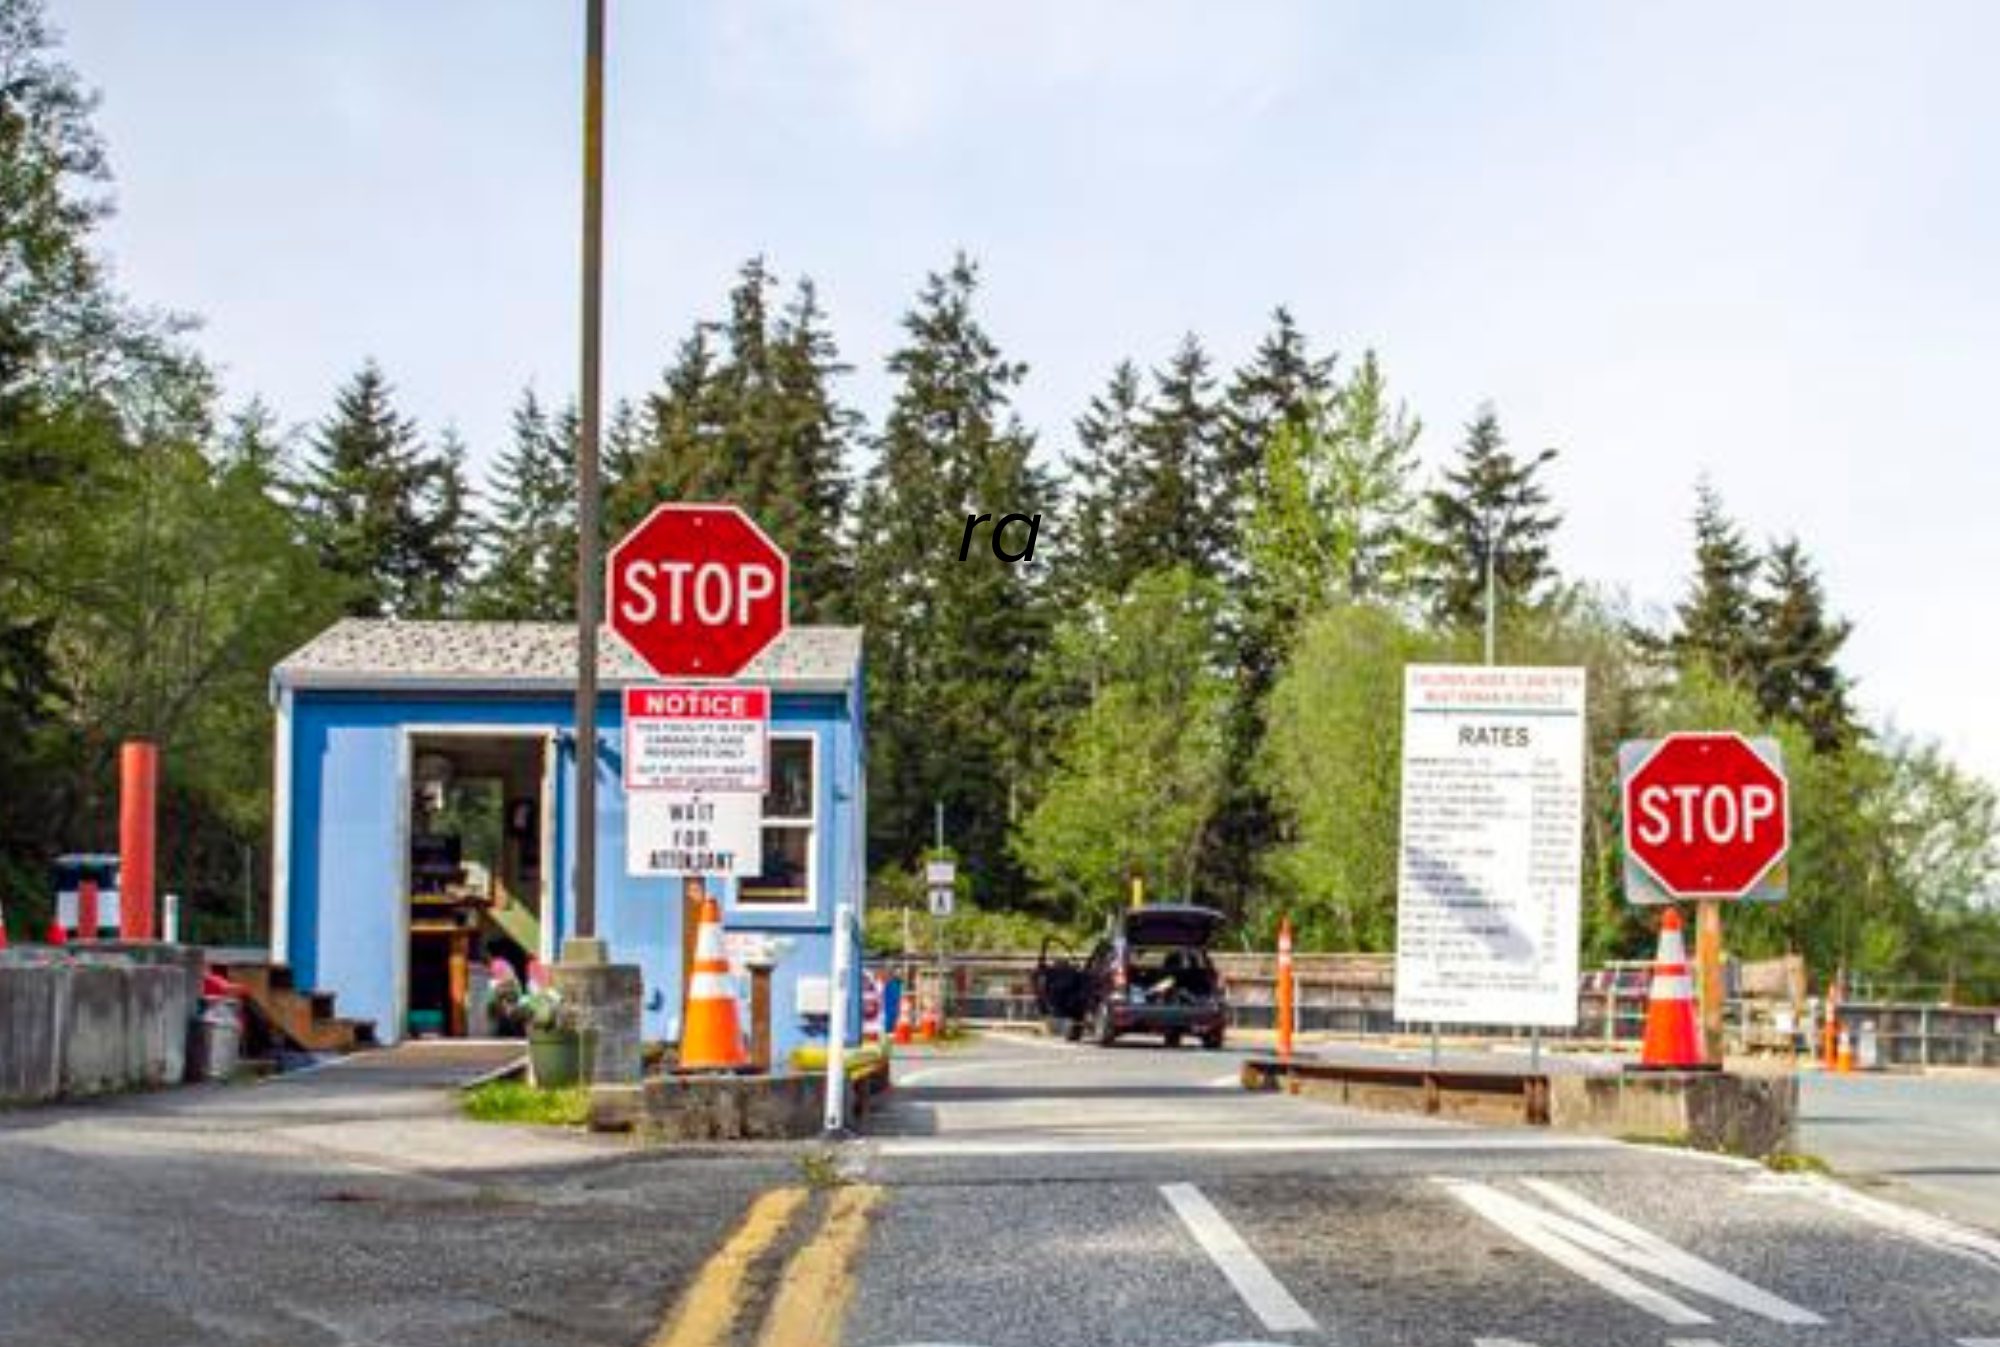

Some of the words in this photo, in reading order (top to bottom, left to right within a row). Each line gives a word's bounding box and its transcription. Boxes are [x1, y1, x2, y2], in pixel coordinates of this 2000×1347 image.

[621, 560, 775, 626] STOP
[646, 693, 746, 713] NOTICE
[1458, 726, 1530, 748] RATES
[668, 804, 715, 821] WAIT
[1637, 783, 1776, 847] STOP
[673, 829, 709, 847] FOR
